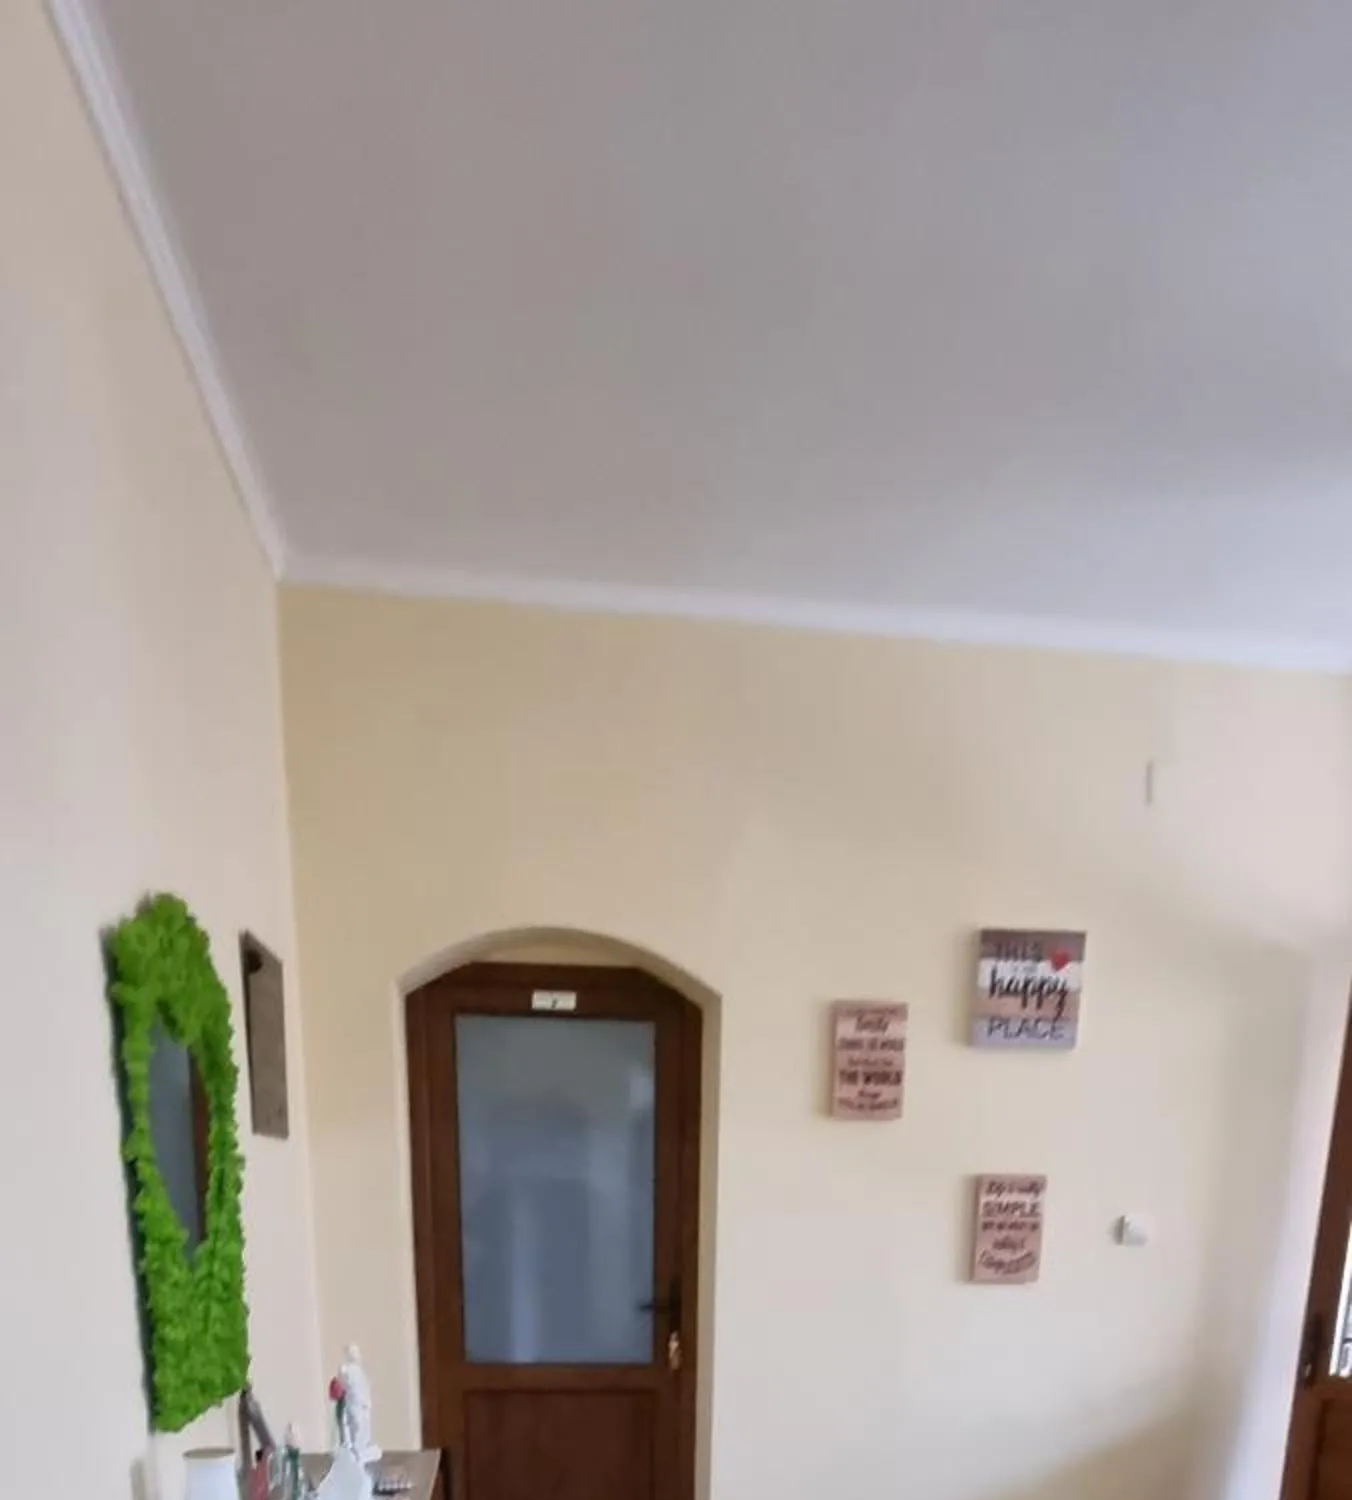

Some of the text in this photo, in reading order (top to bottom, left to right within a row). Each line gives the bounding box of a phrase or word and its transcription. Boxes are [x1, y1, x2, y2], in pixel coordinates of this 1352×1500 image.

[994, 940, 1042, 961] THIS
[989, 966, 1067, 1020] happy
[987, 1018, 1068, 1039] PLACE
[982, 1201, 1041, 1217] SIMPLE
